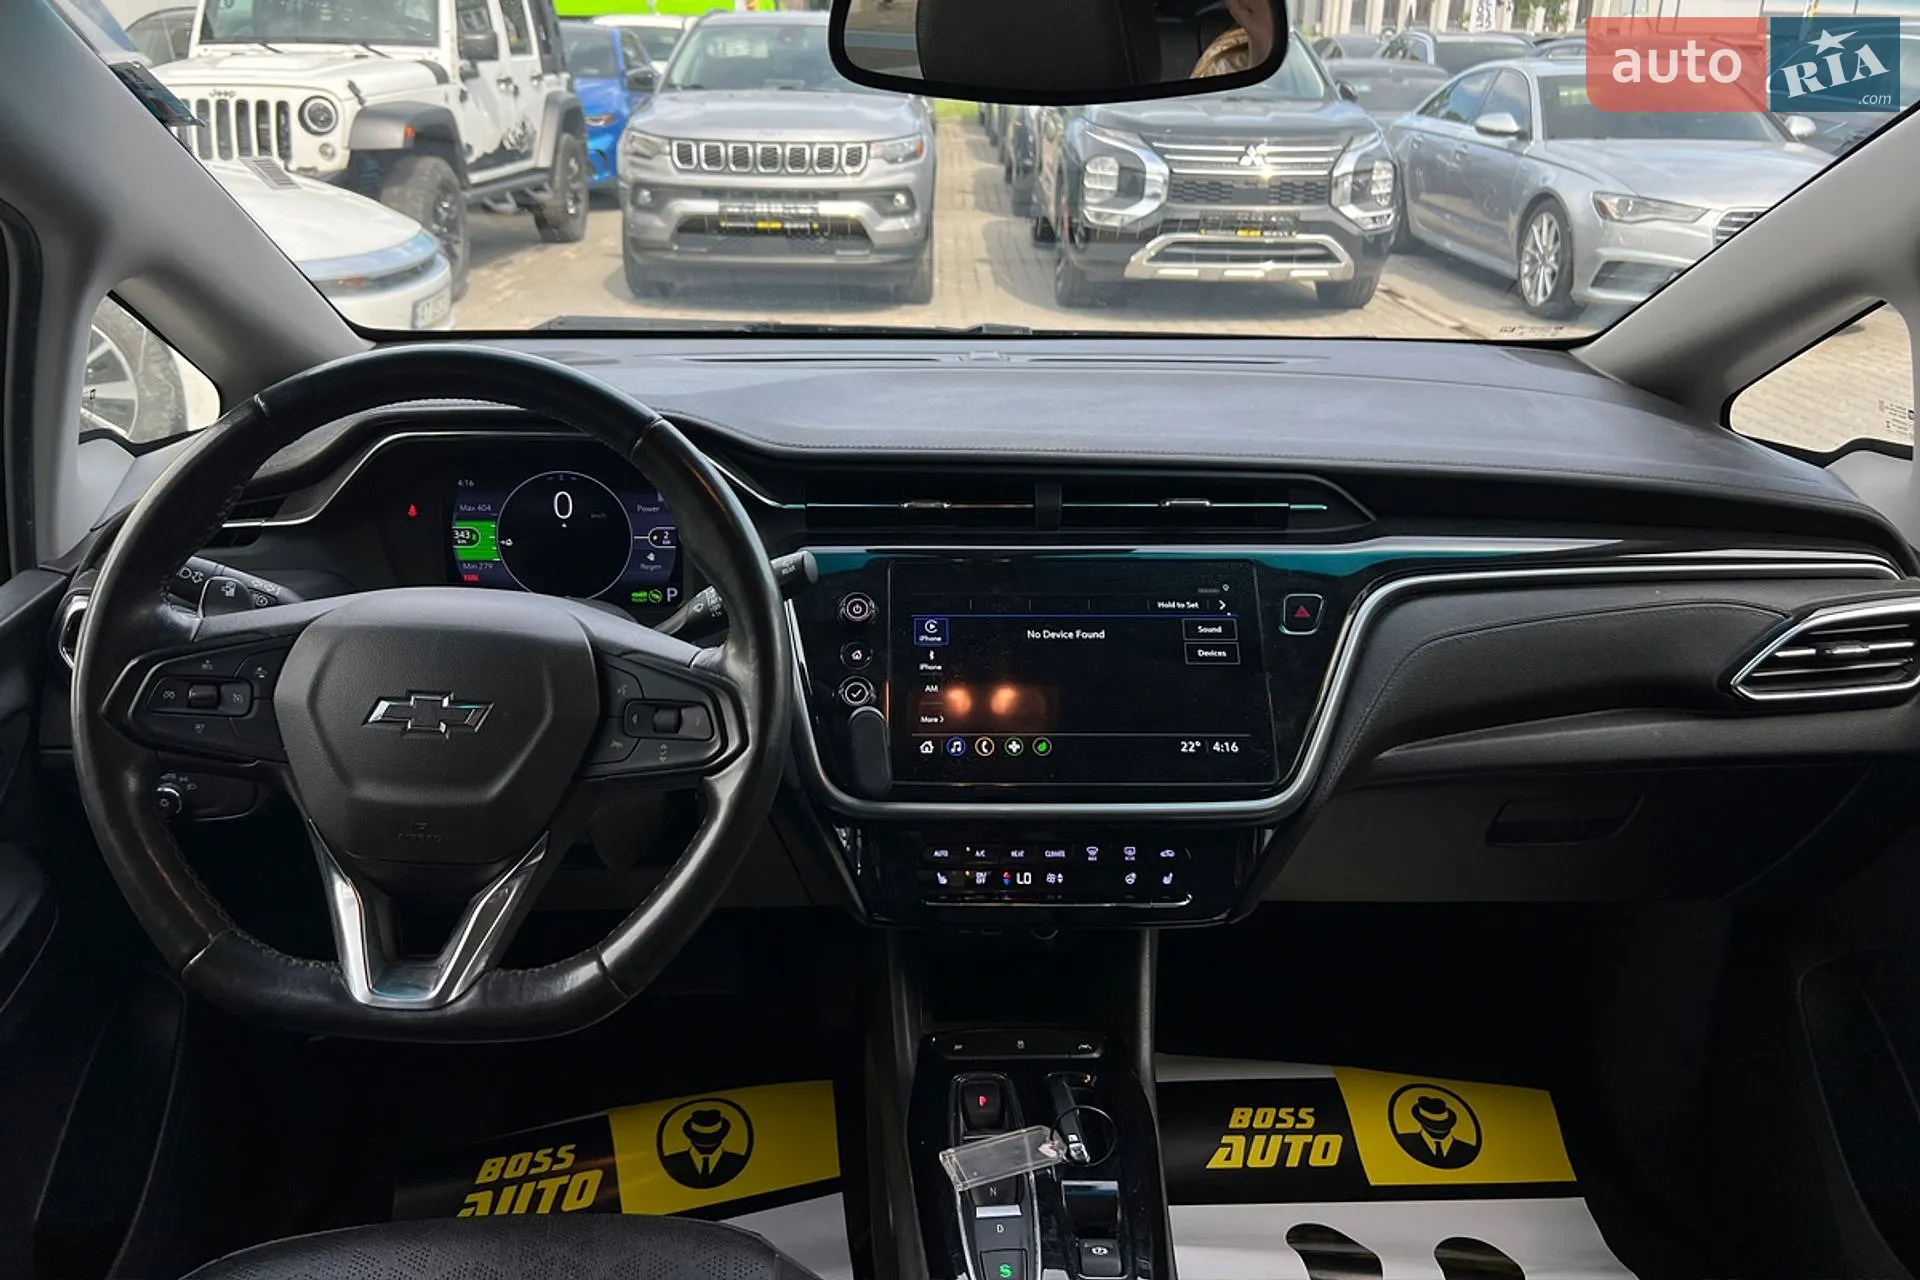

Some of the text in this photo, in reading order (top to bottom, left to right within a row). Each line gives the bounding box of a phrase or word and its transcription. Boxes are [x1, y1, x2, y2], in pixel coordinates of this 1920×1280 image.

[209, 89, 236, 98] Jeep
[554, 491, 573, 519] 0
[637, 504, 660, 513] Power
[453, 530, 470, 538] 343
[663, 531, 669, 539] 2
[640, 564, 662, 572] Regen
[666, 587, 678, 602] P
[1157, 601, 1199, 609] Hold to Set
[1198, 625, 1222, 633] Sound
[1027, 629, 1106, 639] No Device Found
[1197, 649, 1227, 657] Devices
[925, 685, 939, 693] AM
[920, 715, 939, 723] More
[1181, 740, 1239, 753] 22° 4:16
[1016, 872, 1032, 885] LO
[979, 1096, 987, 1106] P
[1228, 1107, 1315, 1129] BOSS
[1205, 1134, 1344, 1168] AUTO
[475, 1144, 576, 1184] BOSS
[456, 1169, 603, 1217] AUTO
[990, 1187, 997, 1197] N
[996, 1224, 1004, 1233] D
